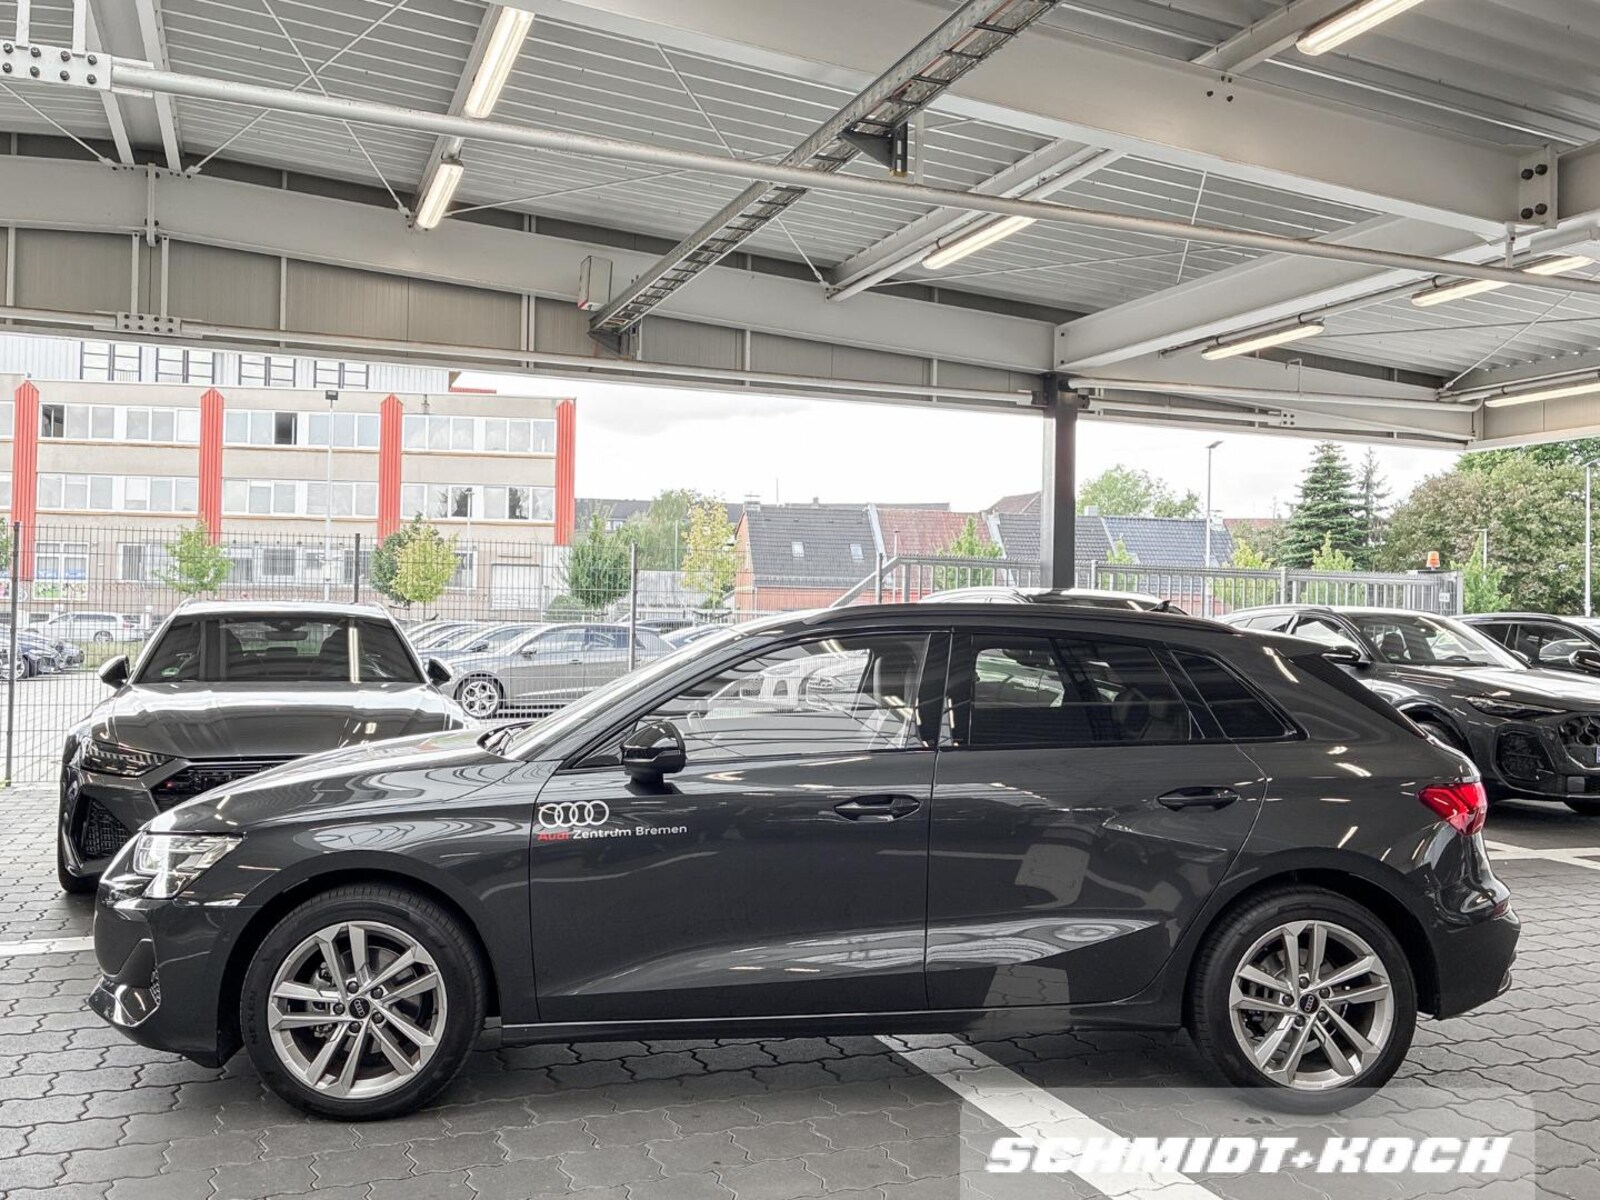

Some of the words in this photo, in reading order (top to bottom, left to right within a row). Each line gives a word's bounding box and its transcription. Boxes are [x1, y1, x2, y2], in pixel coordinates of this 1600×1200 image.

[538, 831, 570, 842] Audi
[573, 829, 632, 840] Zentrum
[635, 826, 688, 836] Bremen
